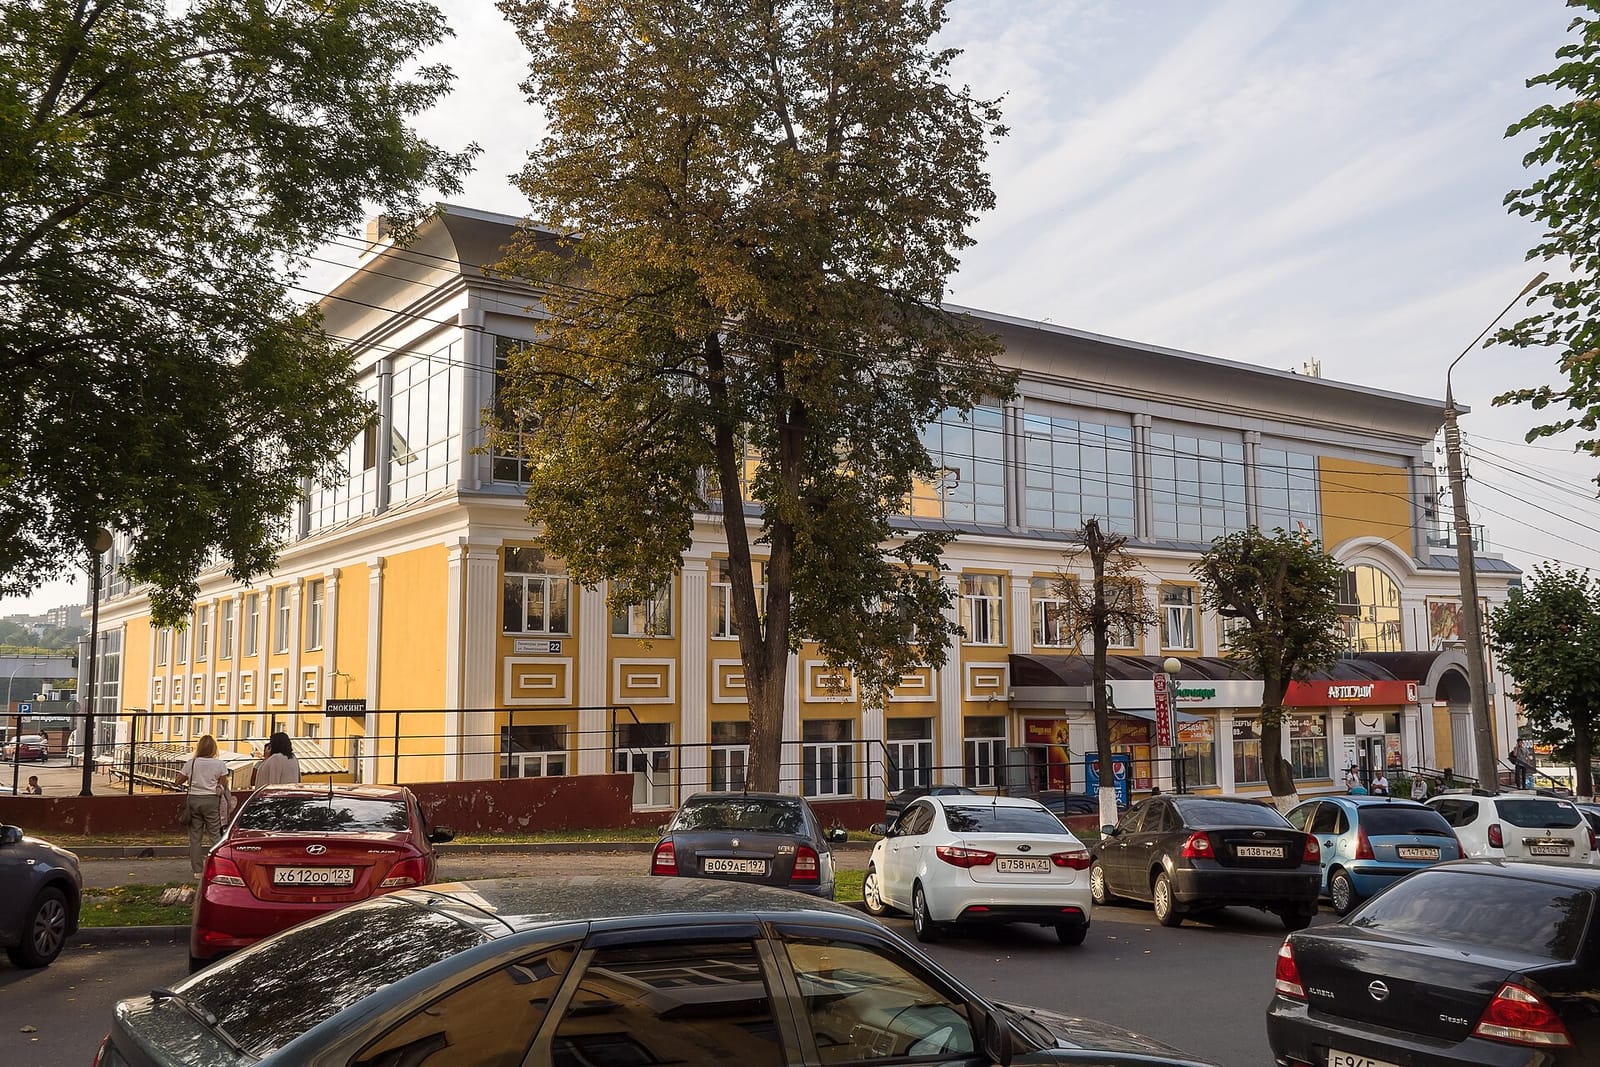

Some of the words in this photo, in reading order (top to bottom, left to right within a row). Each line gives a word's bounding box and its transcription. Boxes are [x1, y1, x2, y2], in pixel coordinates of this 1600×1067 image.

[550, 643, 560, 651] 22
[22, 705, 29, 713] P
[327, 704, 365, 712] СМОКИНГ
[707, 860, 746, 871] В069АЕ
[748, 860, 763, 869] 197
[1001, 859, 1036, 870] В758НА
[331, 869, 351, 880] 123
[1439, 1014, 1469, 1026] Classic
